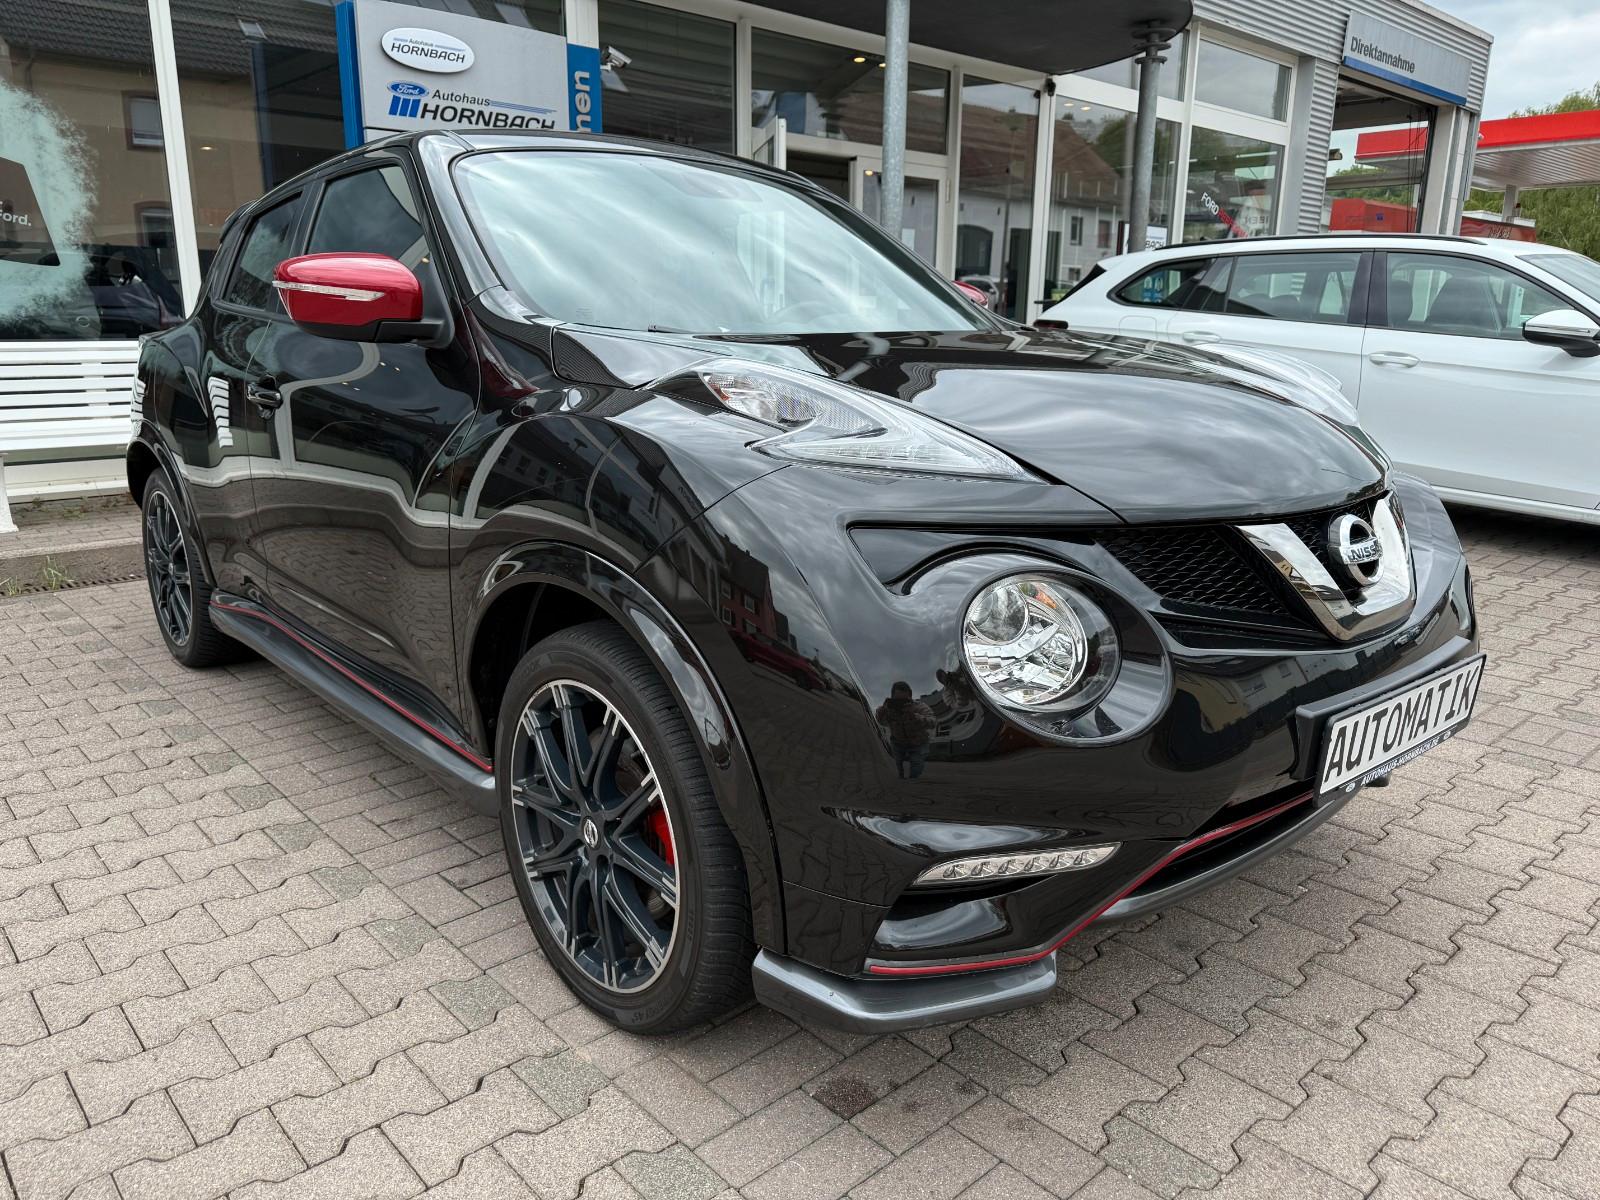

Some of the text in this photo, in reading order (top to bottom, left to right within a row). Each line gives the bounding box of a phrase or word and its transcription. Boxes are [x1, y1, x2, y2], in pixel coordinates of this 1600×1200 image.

[391, 42, 465, 63] HORNBACH
[408, 38, 434, 47] Autohaus
[1350, 36, 1416, 73] Direktannahme
[397, 83, 419, 95] Ford
[432, 89, 491, 107] Autohaus
[420, 103, 556, 130] HORNBACH
[1323, 665, 1480, 783] AUTOMATIK
